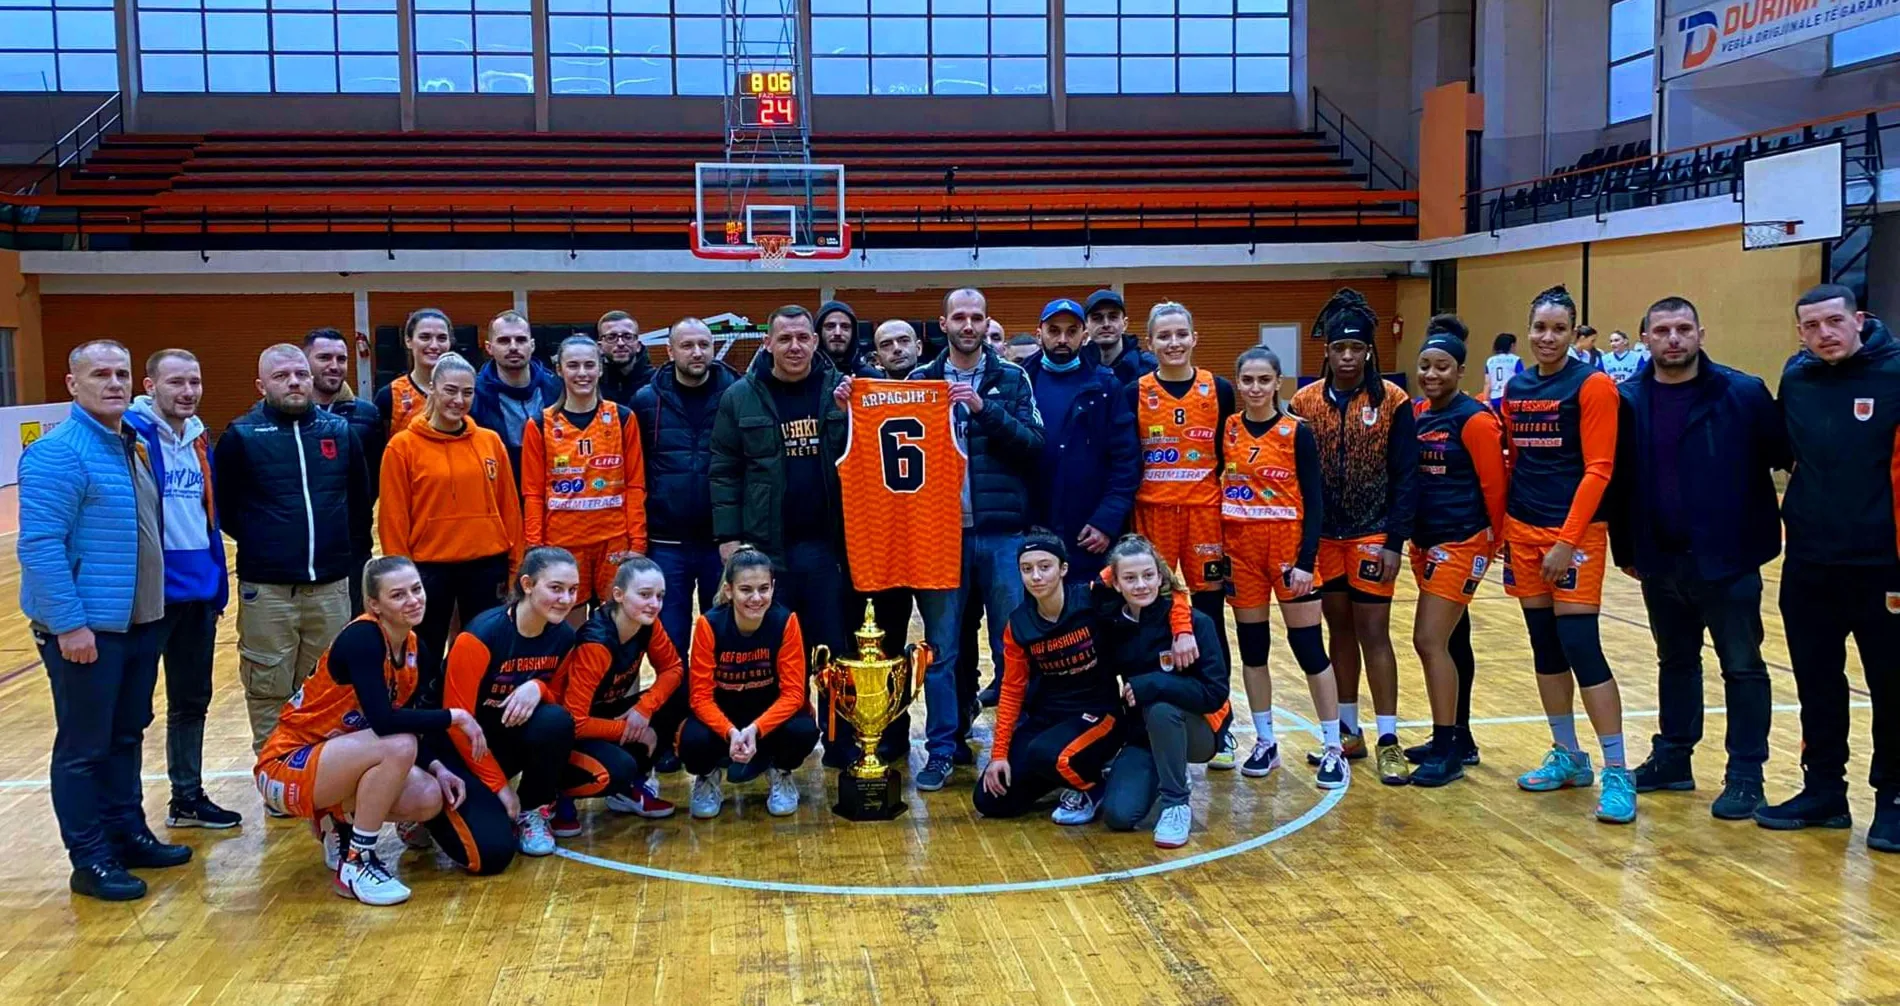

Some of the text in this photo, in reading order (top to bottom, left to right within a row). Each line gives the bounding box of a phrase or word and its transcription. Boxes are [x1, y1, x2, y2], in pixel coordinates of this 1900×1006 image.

[761, 99, 792, 123] 24
[1173, 407, 1185, 426] 8
[1189, 429, 1214, 439] LIRI
[576, 438, 593, 456] 11
[878, 417, 925, 493] 6
[1248, 446, 1261, 464] 7
[594, 457, 620, 466] LIRI
[1262, 469, 1289, 478] LIRI
